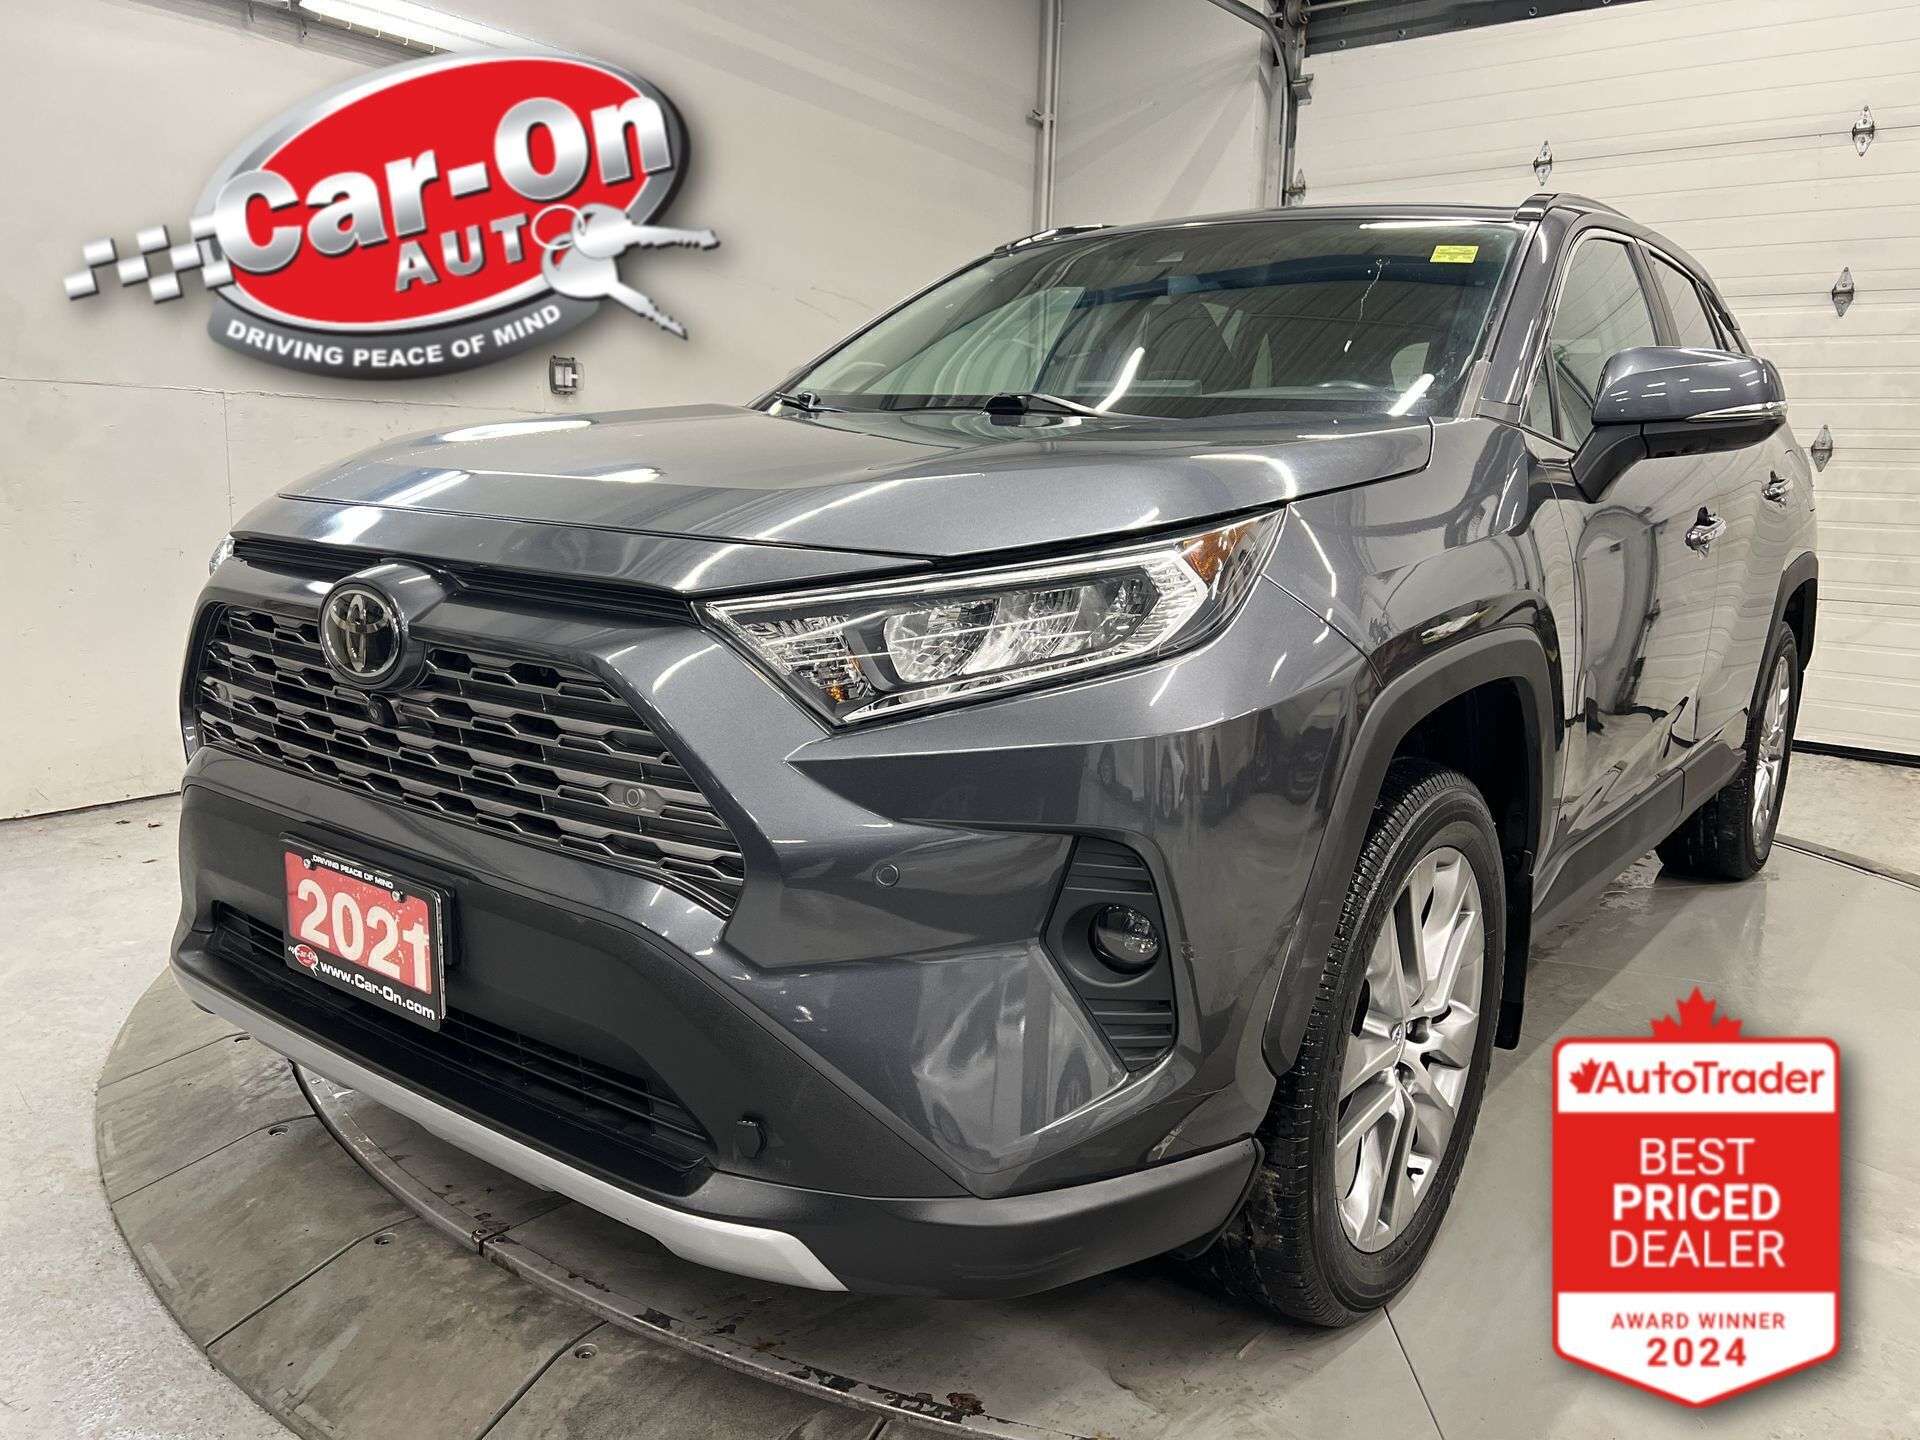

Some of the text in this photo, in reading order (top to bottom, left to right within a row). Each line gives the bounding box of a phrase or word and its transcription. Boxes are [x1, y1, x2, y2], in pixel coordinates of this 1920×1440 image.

[312, 854, 394, 889] DRIVING PEACE OF MIND
[297, 878, 430, 994] 2021
[319, 961, 436, 1021] www.Car-On.com
